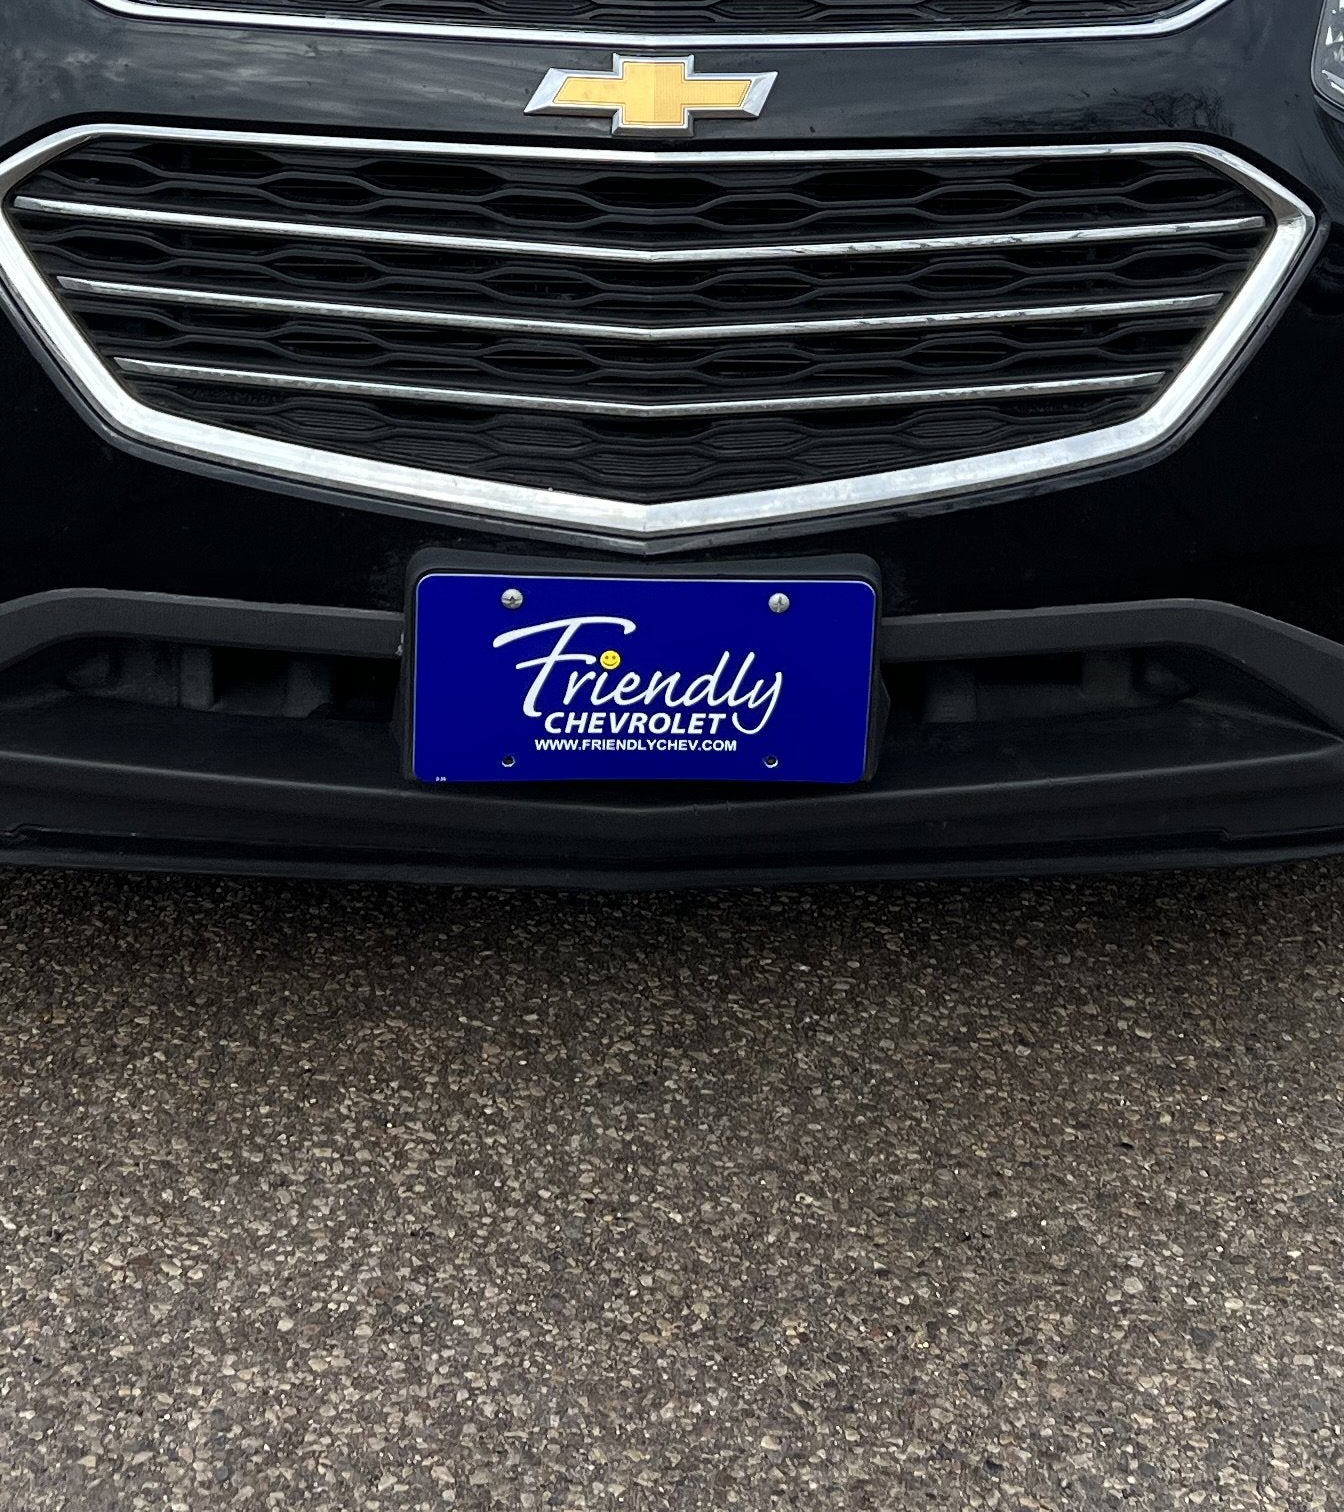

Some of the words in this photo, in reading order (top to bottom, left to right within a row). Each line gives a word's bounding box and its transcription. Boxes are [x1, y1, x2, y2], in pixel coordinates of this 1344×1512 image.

[493, 616, 783, 734] Friendly
[544, 711, 727, 734] CHEVROLET
[534, 738, 738, 752] WWW.FRIENDLYCHEV.COM
